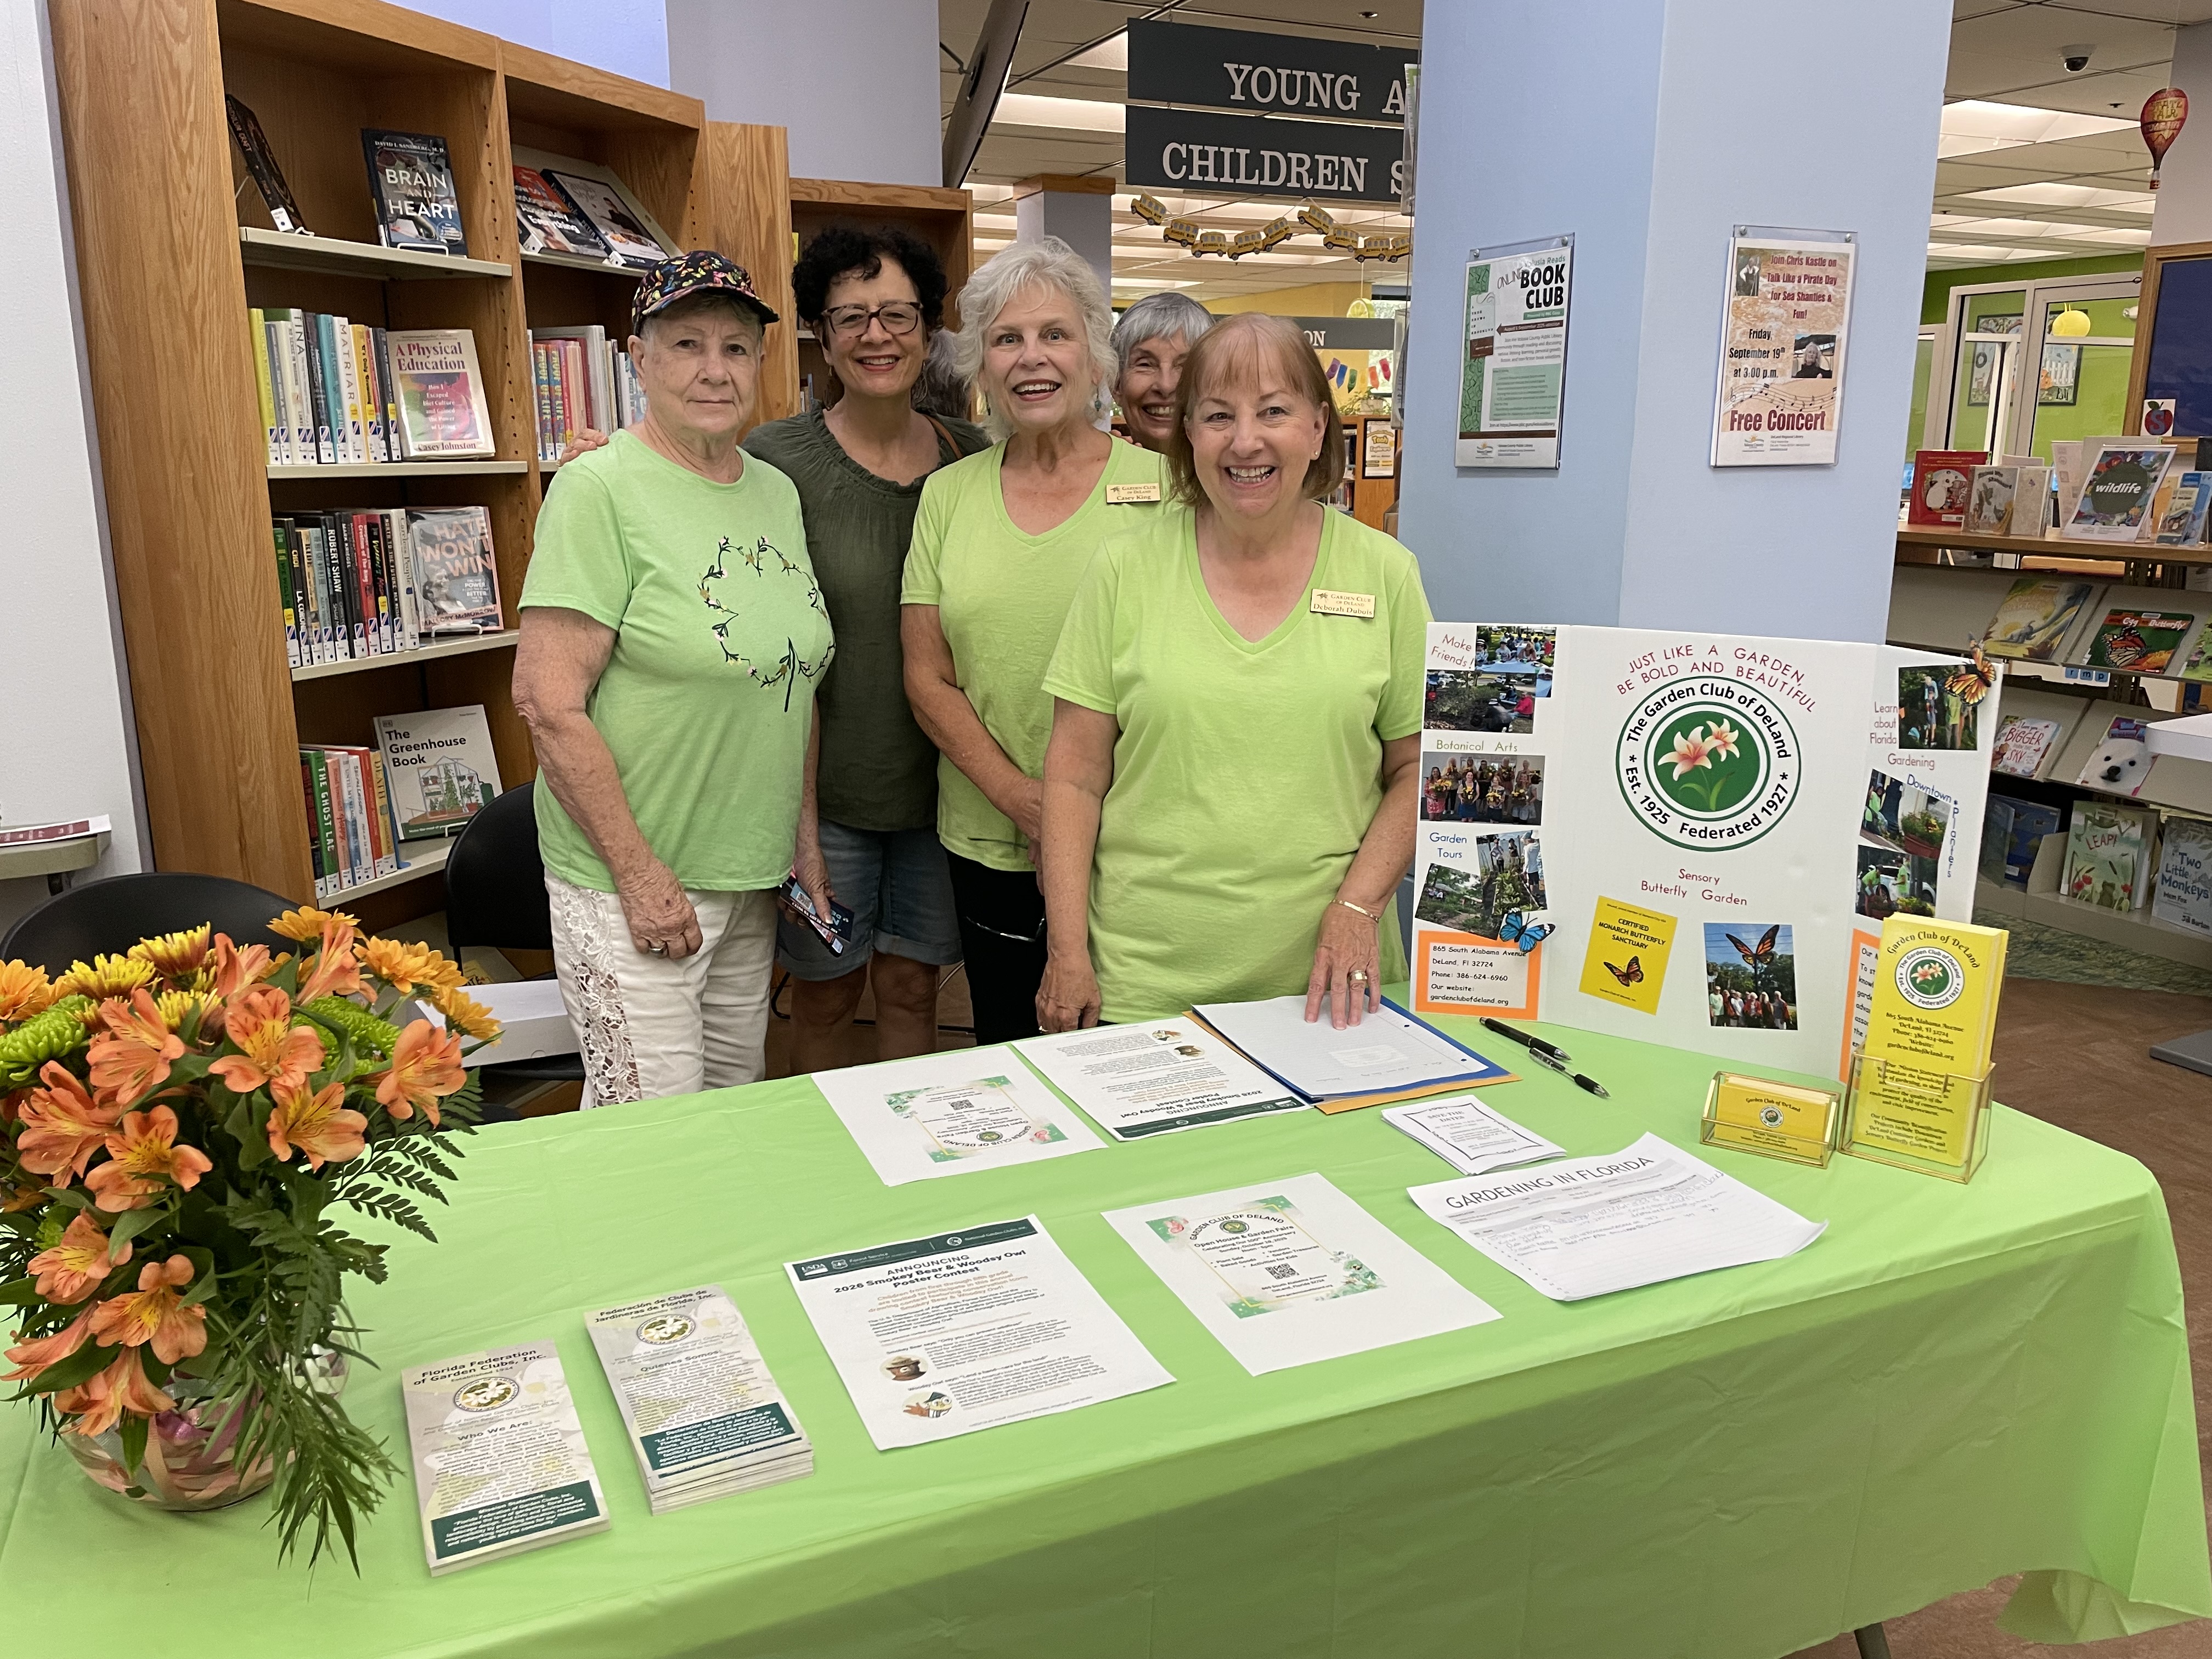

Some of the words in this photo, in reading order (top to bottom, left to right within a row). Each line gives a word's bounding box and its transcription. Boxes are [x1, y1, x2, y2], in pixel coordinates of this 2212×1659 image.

[1223, 62, 1361, 111] YOUNG
[1163, 142, 1369, 193] CHILDREN
[385, 168, 447, 189] BRAIN
[407, 189, 432, 198] AND
[388, 199, 455, 219] HEART
[1547, 256, 1566, 264] Reads
[1771, 255, 1785, 264] Join
[1787, 255, 1803, 266] Chris
[1805, 256, 1826, 267] Kastle
[1828, 258, 1837, 267] on
[1520, 263, 1565, 289] BOOK
[1767, 273, 1780, 283] Talk
[1782, 273, 1795, 283] Like
[1803, 274, 1822, 284] Pirate
[1825, 275, 1837, 286] Day
[1526, 286, 1564, 309] CLUB
[1771, 291, 1781, 301] for
[1782, 292, 1795, 301] Sea
[1797, 292, 1825, 302] Shanties
[1827, 294, 1832, 302] &
[1793, 309, 1807, 319] Fun!
[294, 315, 304, 355] TINA
[1749, 329, 1772, 341] Friday,
[396, 343, 405, 357] A
[407, 342, 463, 358] Physical
[1729, 347, 1770, 359] September
[398, 357, 466, 371] Education
[1734, 368, 1741, 377] at
[1743, 368, 1760, 378] 3:00
[1762, 369, 1779, 379] p.m.
[1730, 410, 1762, 431] Free
[1767, 410, 1826, 431] Concert
[2095, 481, 2141, 494] wildlife
[436, 516, 488, 541] HATE
[328, 528, 339, 565] ROBERT
[418, 538, 493, 563] WON'T
[445, 556, 494, 577] WIN
[331, 566, 342, 593] SHAW
[1313, 603, 1344, 612] Deborah
[2148, 619, 2187, 631] Butterfly
[1442, 634, 1472, 653] Make
[1628, 652, 1657, 674] JUST
[1663, 644, 1694, 660] LIKE
[1708, 645, 1718, 656] A
[1734, 647, 1805, 687] GARDEN,
[1617, 679, 1635, 695] BE
[1641, 664, 1679, 685] BOLD
[1690, 662, 1724, 673] AND
[1736, 666, 1816, 713] BEAUTIFUL
[1874, 701, 1899, 714] Learn
[1626, 717, 1647, 743] The
[1644, 685, 1696, 718] Garden
[1700, 683, 1735, 700] Club
[1737, 693, 1757, 709] of
[1753, 704, 1792, 759] DeLand
[1874, 718, 1897, 729] about
[385, 730, 410, 741] The
[1869, 732, 1898, 745] Florida
[388, 736, 467, 754] Greenhouse
[1436, 740, 1485, 752] Botanical
[1494, 742, 1518, 753] Arts
[392, 754, 427, 767] Book
[1887, 753, 1936, 771] Gardening
[2007, 749, 2027, 763] SKY
[318, 766, 328, 787] THE
[1907, 773, 1952, 804] Downtown
[321, 792, 332, 826] GHOST
[1625, 766, 1641, 795] Est.
[1640, 794, 1671, 825] 1925
[1679, 814, 1763, 839] Federated
[1760, 783, 1790, 817] 1927
[1429, 832, 1468, 844] Garden
[1947, 807, 1960, 878] Planters
[1437, 847, 1463, 859] Tours
[2178, 851, 2202, 870] Two
[1678, 868, 1721, 885] Sensory
[2165, 863, 2190, 879] Little
[1641, 880, 1688, 899] Butterfly
[1701, 888, 1748, 906] Garden
[2160, 873, 2210, 901] Monkeys
[1598, 921, 1629, 935] MONARCH
[1630, 930, 1666, 946] BUTTERFLY
[1618, 918, 1649, 932] CERTIFIED
[1612, 934, 1649, 949] SANCTUARY
[1887, 934, 1916, 955] Garden
[1917, 931, 1938, 940] Club
[1940, 935, 1951, 944] of
[1952, 938, 1980, 969] DeLand
[1448, 946, 1468, 954] South
[1471, 947, 1500, 956] Alabama
[1502, 949, 1527, 957] Avenue
[1861, 947, 1872, 957] Our
[1432, 958, 1459, 967] DeLand,
[1899, 958, 1908, 969] The
[1906, 950, 1927, 961] Garden
[1948, 958, 1961, 979] DeLand
[1456, 972, 1508, 981] 386-624-6960
[1430, 994, 1509, 1006] gardenclubofdeland.org
[1918, 997, 1950, 1006] Federated
[1446, 1178, 1554, 1209] GARDENING
[1555, 1172, 1578, 1184] IN
[1577, 1156, 1655, 1181] FLORIDA
[1209, 1215, 1231, 1224] CLUB
[1247, 1214, 1284, 1223] DELAND
[1216, 1235, 1240, 1244] House
[834, 1283, 865, 1294] 2026
[866, 1272, 915, 1286] Smokey
[915, 1268, 944, 1279] Bear
[957, 1255, 1003, 1268] Woodsy
[1005, 1249, 1027, 1259] Owl
[888, 1255, 970, 1276] ANNOUNCING
[893, 1276, 933, 1288] Poster
[934, 1266, 980, 1279] Contest
[422, 1364, 466, 1378] Florida
[470, 1350, 537, 1367] Federation
[430, 1368, 476, 1382] Garden
[480, 1359, 519, 1371] Clubs,
[458, 1431, 484, 1441] Who
[510, 1420, 532, 1430] Are:
